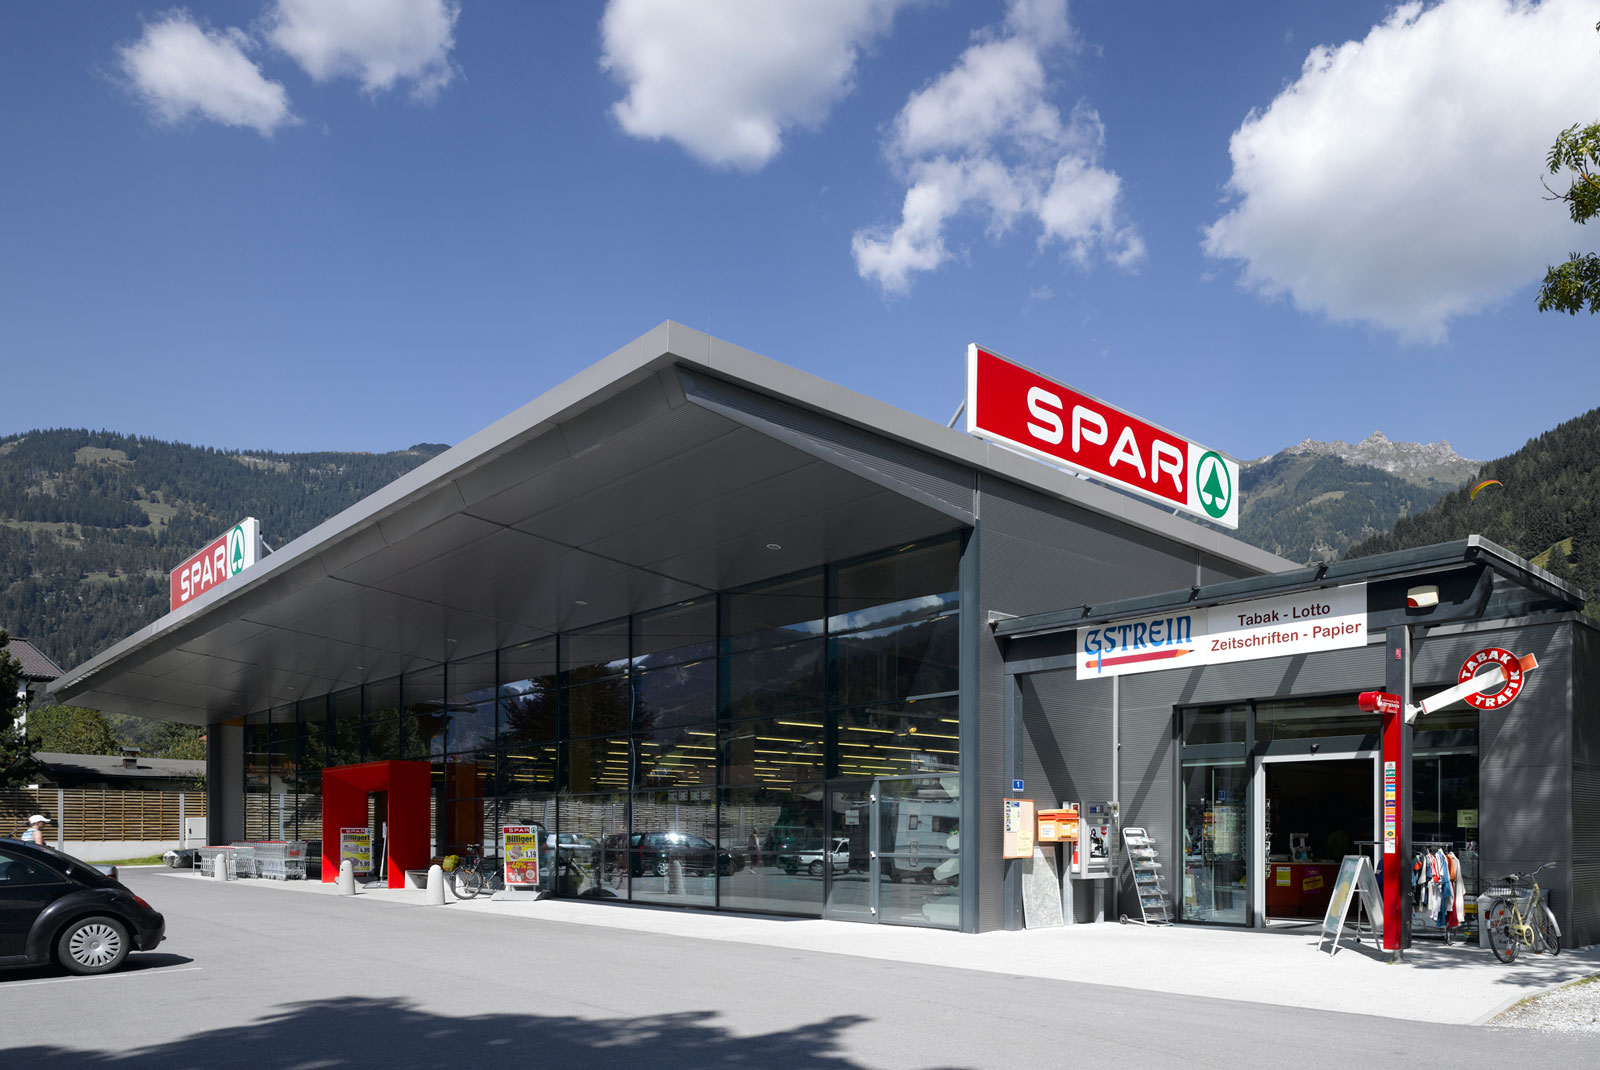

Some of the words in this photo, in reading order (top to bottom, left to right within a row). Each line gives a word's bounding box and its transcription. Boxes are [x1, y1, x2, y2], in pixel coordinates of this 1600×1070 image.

[1027, 386, 1184, 493] SPAR
[181, 545, 225, 602] SPAR
[1238, 610, 1280, 627] Tabak
[1292, 603, 1331, 619] Lotto
[1084, 615, 1193, 672] GSTREIN
[1210, 631, 1299, 652] Zeitschriften
[1312, 622, 1362, 641] Papier
[1461, 650, 1512, 679] TABAK
[1475, 669, 1520, 707] TRAFIK
[506, 835, 536, 843] Billiger!
[525, 850, 536, 859] 1,19
